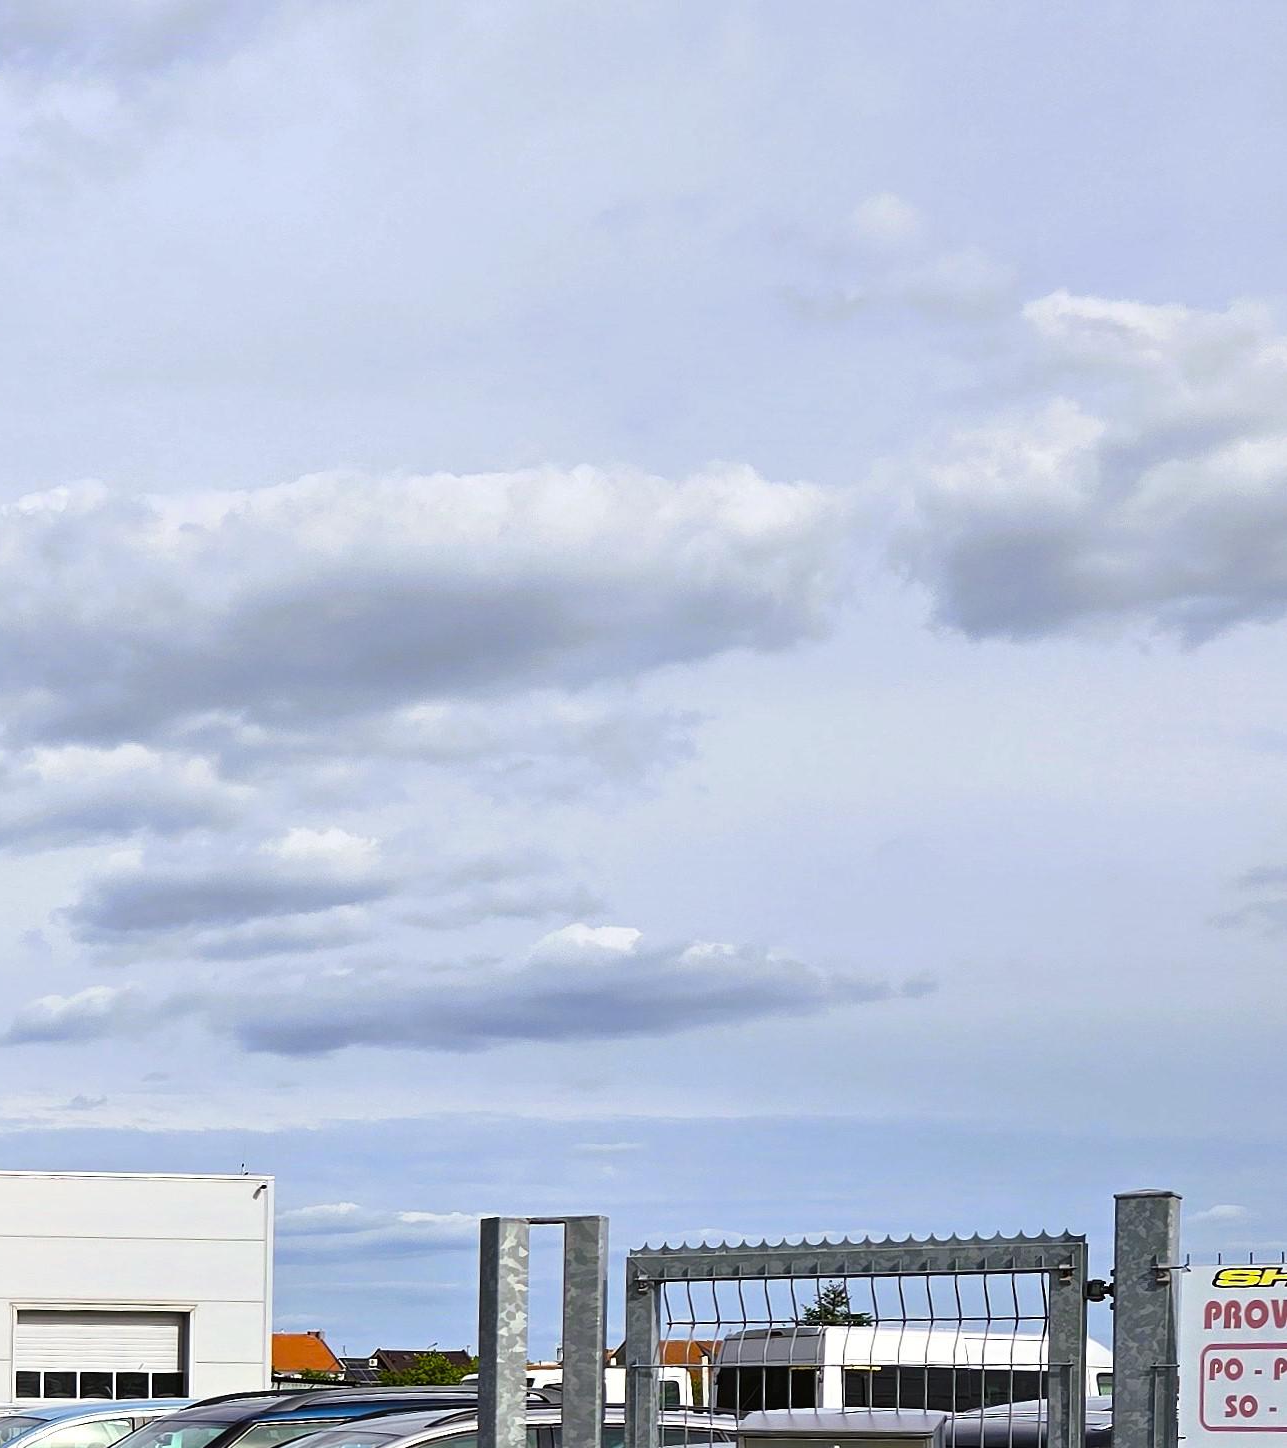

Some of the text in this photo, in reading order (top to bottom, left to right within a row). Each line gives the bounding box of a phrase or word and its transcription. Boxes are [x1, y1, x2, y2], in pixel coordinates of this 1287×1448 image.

[1204, 1299, 1287, 1329] PROV
[1209, 1358, 1244, 1381] PO
[1225, 1395, 1259, 1418] SO
